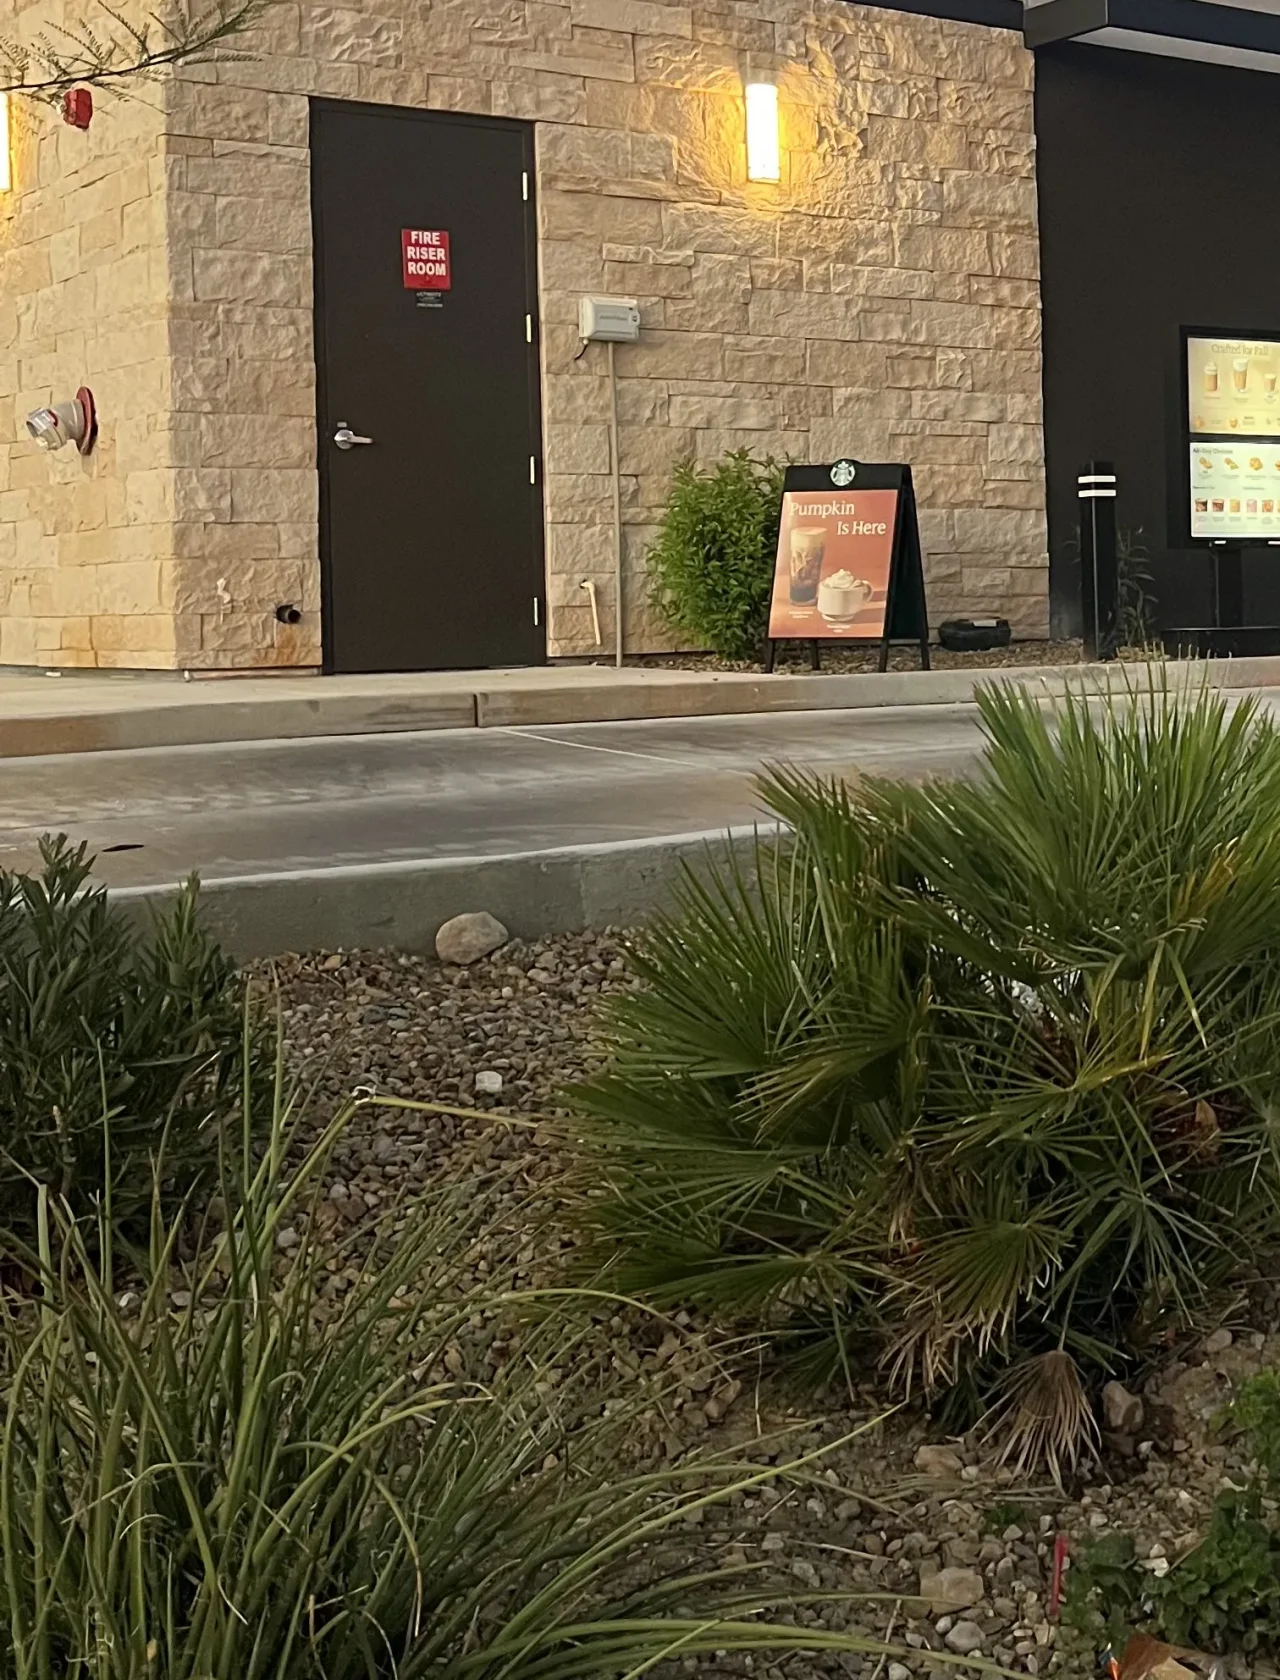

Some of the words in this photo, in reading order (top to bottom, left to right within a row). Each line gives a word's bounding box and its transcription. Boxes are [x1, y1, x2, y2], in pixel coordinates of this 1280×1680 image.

[411, 231, 441, 245] FIRE
[407, 246, 446, 260] RISER
[408, 261, 446, 275] ROOM
[1211, 343, 1241, 355] Crafted
[789, 500, 855, 519] Pumpkin
[837, 521, 850, 536] Is
[852, 521, 886, 535] Here
